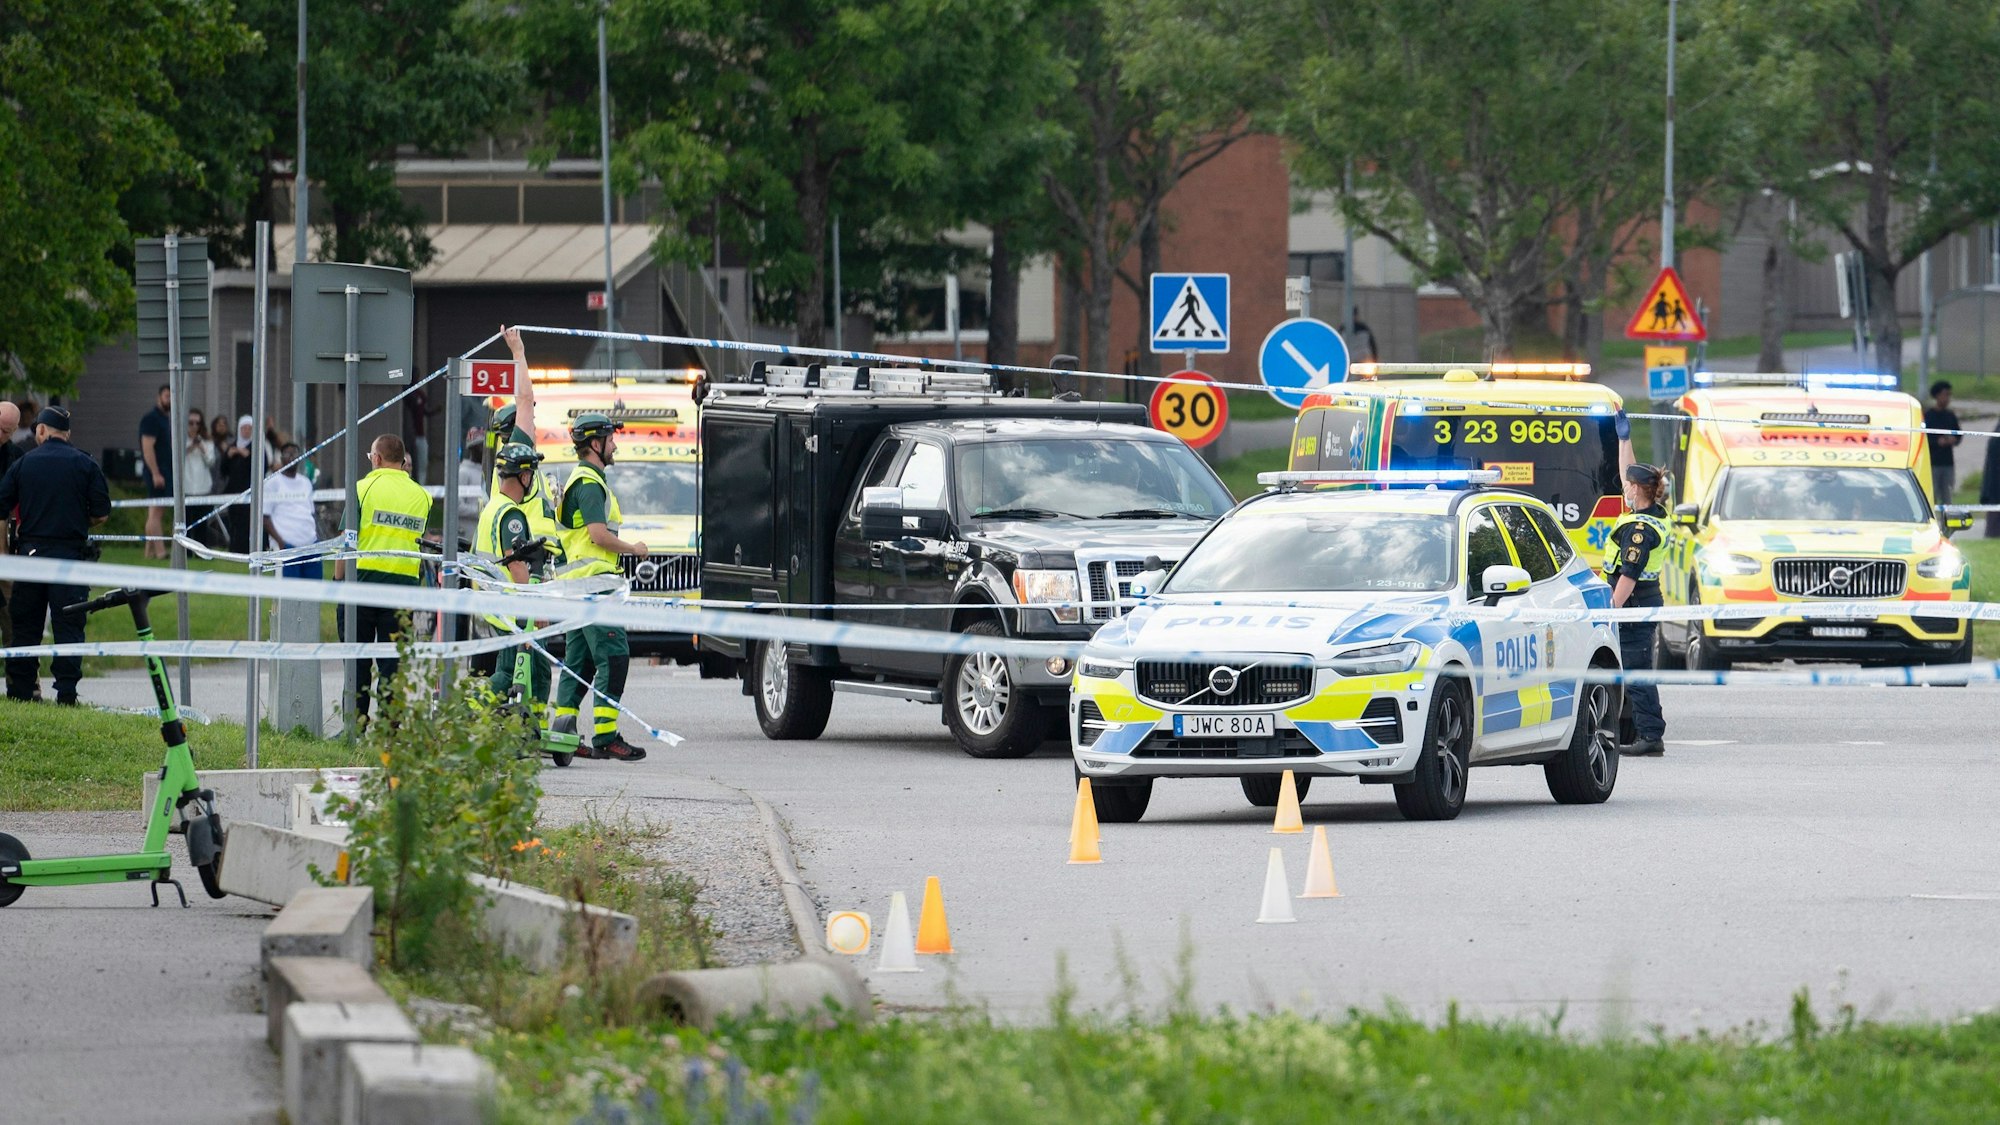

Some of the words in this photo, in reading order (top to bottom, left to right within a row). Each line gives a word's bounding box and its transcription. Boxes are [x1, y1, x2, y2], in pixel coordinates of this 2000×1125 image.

[1662, 371, 1673, 387] P
[1165, 392, 1215, 428] 30
[1433, 420, 1452, 444] 3
[1464, 420, 1498, 444] 23
[1510, 420, 1582, 444] 9650
[632, 445, 690, 457] 9210
[1753, 451, 1768, 461] 3
[1781, 451, 1810, 462] 23
[1823, 451, 1886, 463] 9220
[377, 513, 420, 530] LÄKARE
[1376, 580, 1425, 589] 23-9110
[1164, 615, 1315, 630] POLIS
[1496, 633, 1538, 677] POLIS
[1191, 717, 1224, 733] JWC
[1231, 717, 1265, 733] 80A
